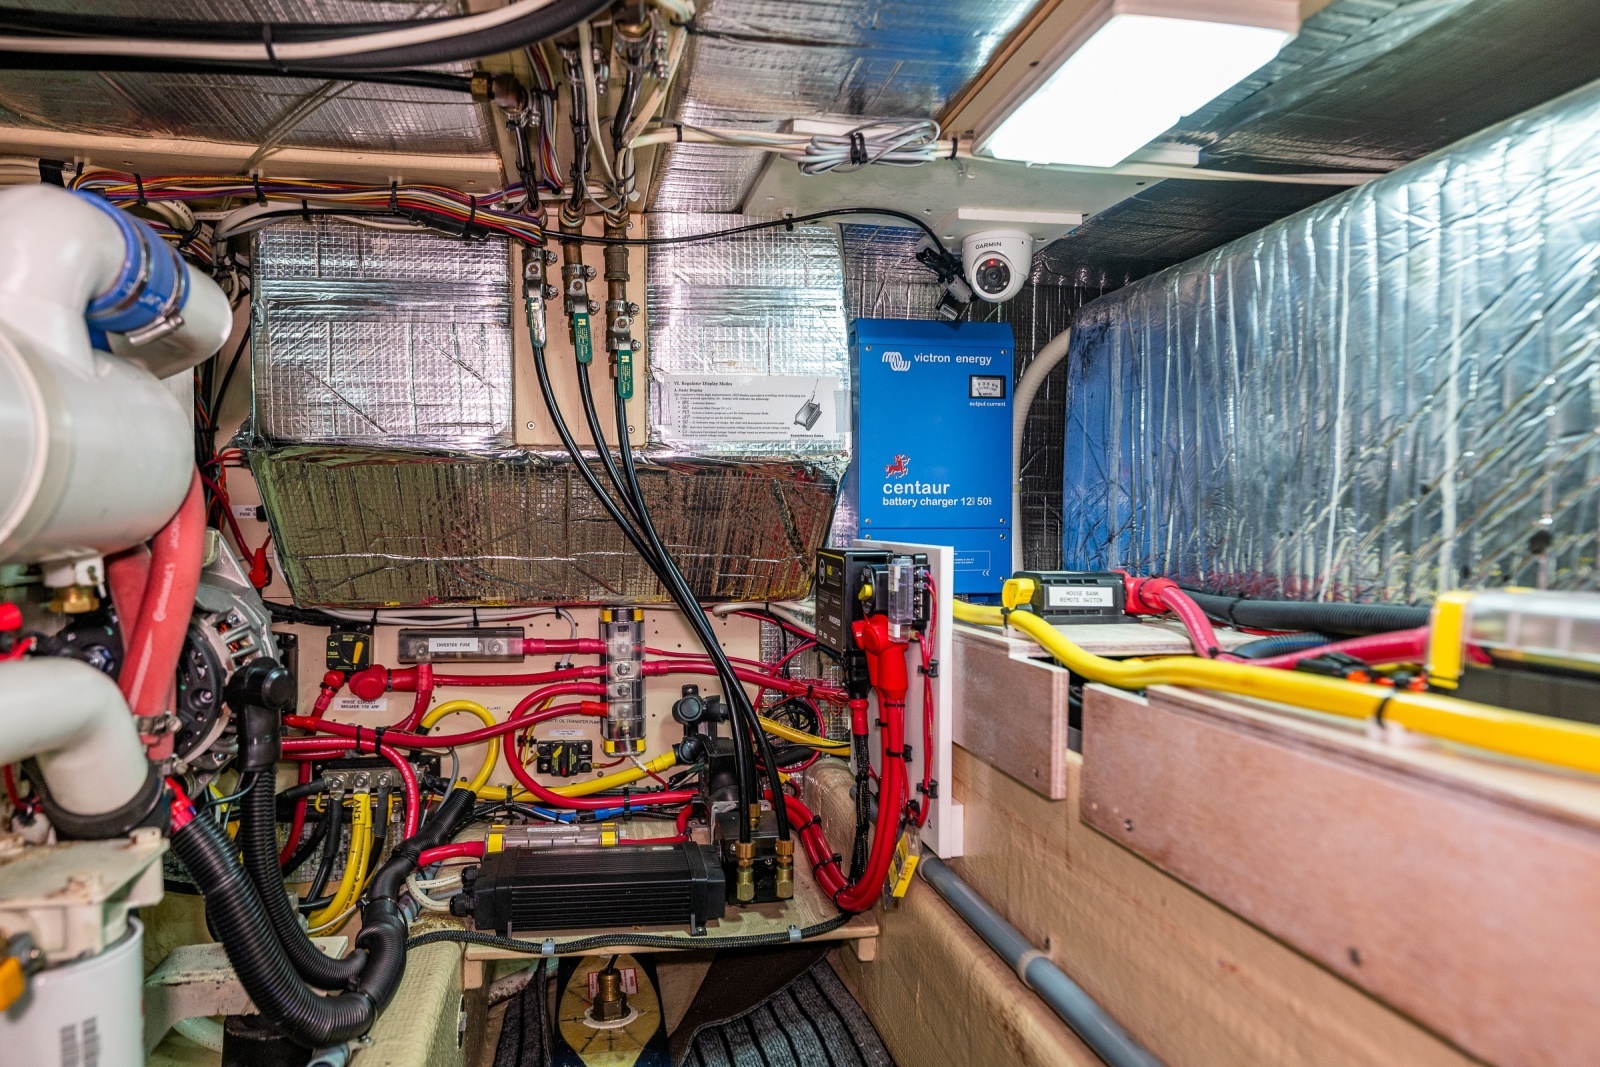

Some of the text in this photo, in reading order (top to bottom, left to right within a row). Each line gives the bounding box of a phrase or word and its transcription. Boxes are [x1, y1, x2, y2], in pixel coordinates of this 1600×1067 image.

[975, 242, 1002, 250] GARMIN
[914, 353, 992, 366] victron energy
[882, 480, 951, 495] centaur
[882, 496, 917, 508] battery
[920, 496, 958, 508] charger
